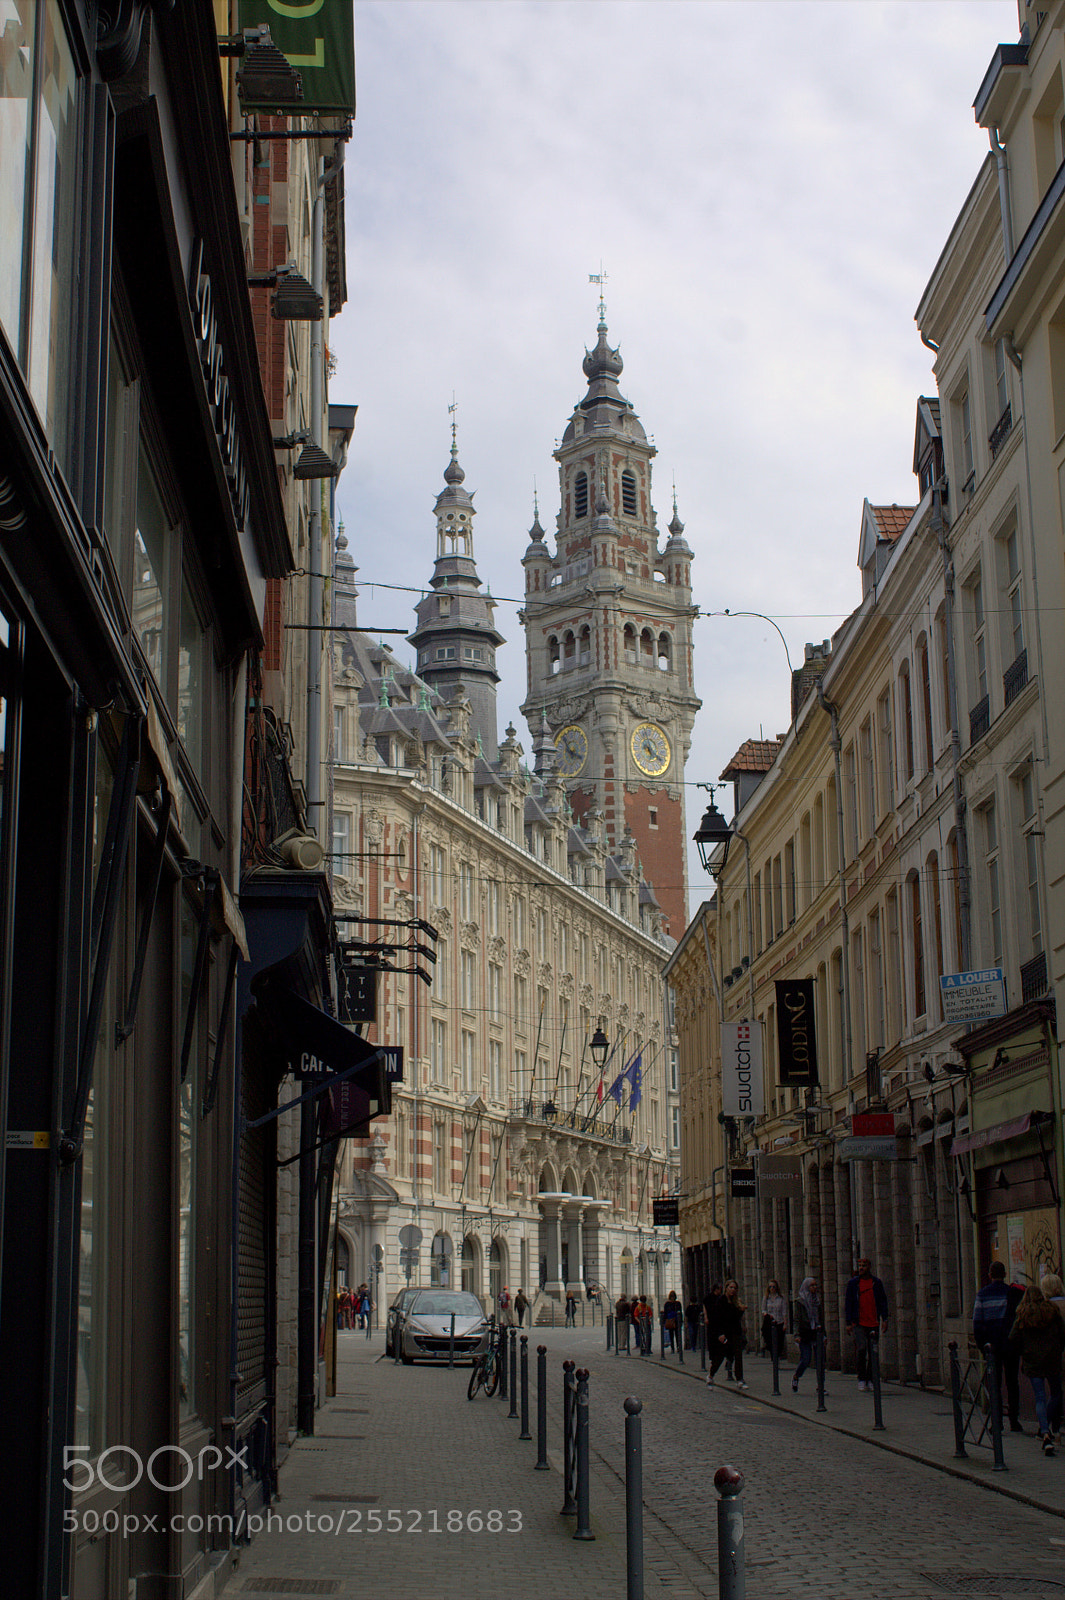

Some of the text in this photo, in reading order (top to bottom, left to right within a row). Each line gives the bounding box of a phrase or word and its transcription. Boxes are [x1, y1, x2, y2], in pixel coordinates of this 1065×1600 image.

[946, 971, 998, 987] A LOUER
[944, 984, 992, 1000] IMMEUBLE
[735, 1041, 752, 1111] swatch
[760, 1172, 794, 1180] swatch
